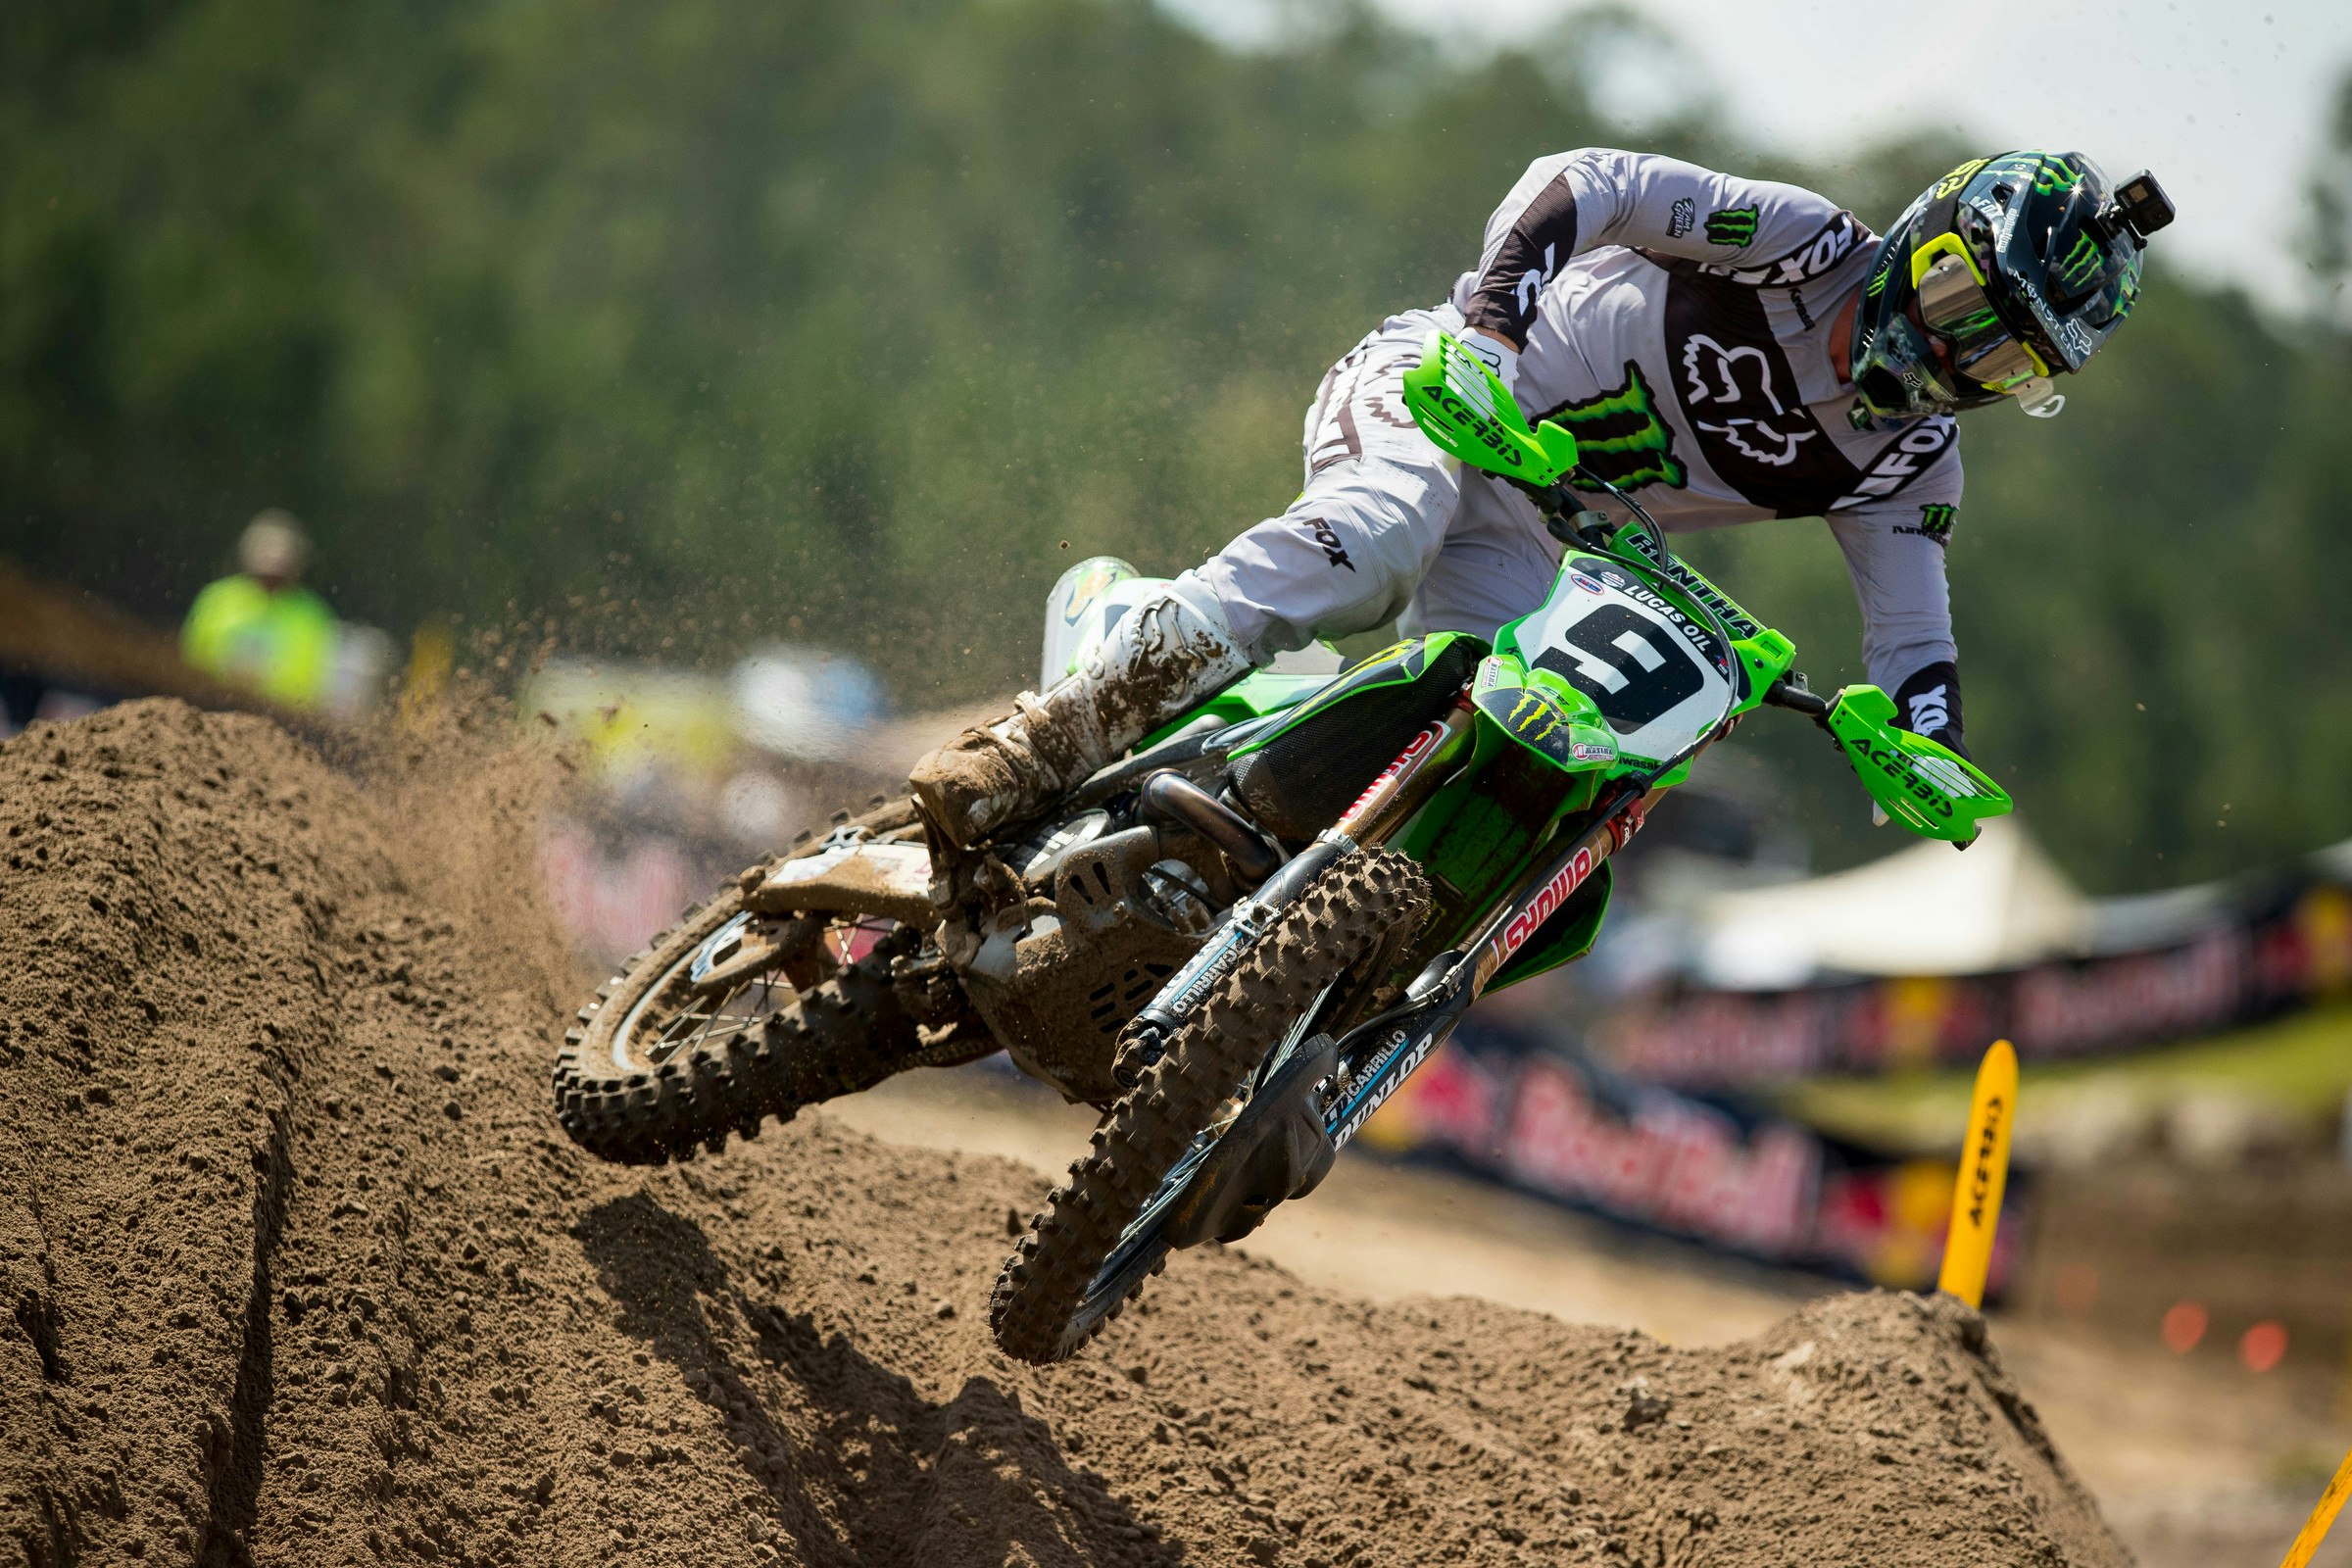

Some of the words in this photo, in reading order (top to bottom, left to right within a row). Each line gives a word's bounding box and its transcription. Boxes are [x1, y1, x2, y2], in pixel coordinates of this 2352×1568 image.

[1770, 212, 1853, 284] FOX
[1870, 413, 1957, 476] FOX
[1302, 516, 1356, 574] FOX
[1623, 584, 1686, 623] LUCAS
[1684, 624, 1711, 652] OIL
[1626, 531, 1762, 640] RENTHA
[1532, 603, 1705, 735] 9
[1335, 1032, 1433, 1152] DUNLOP
[1347, 1030, 1406, 1097] CARRILLO
